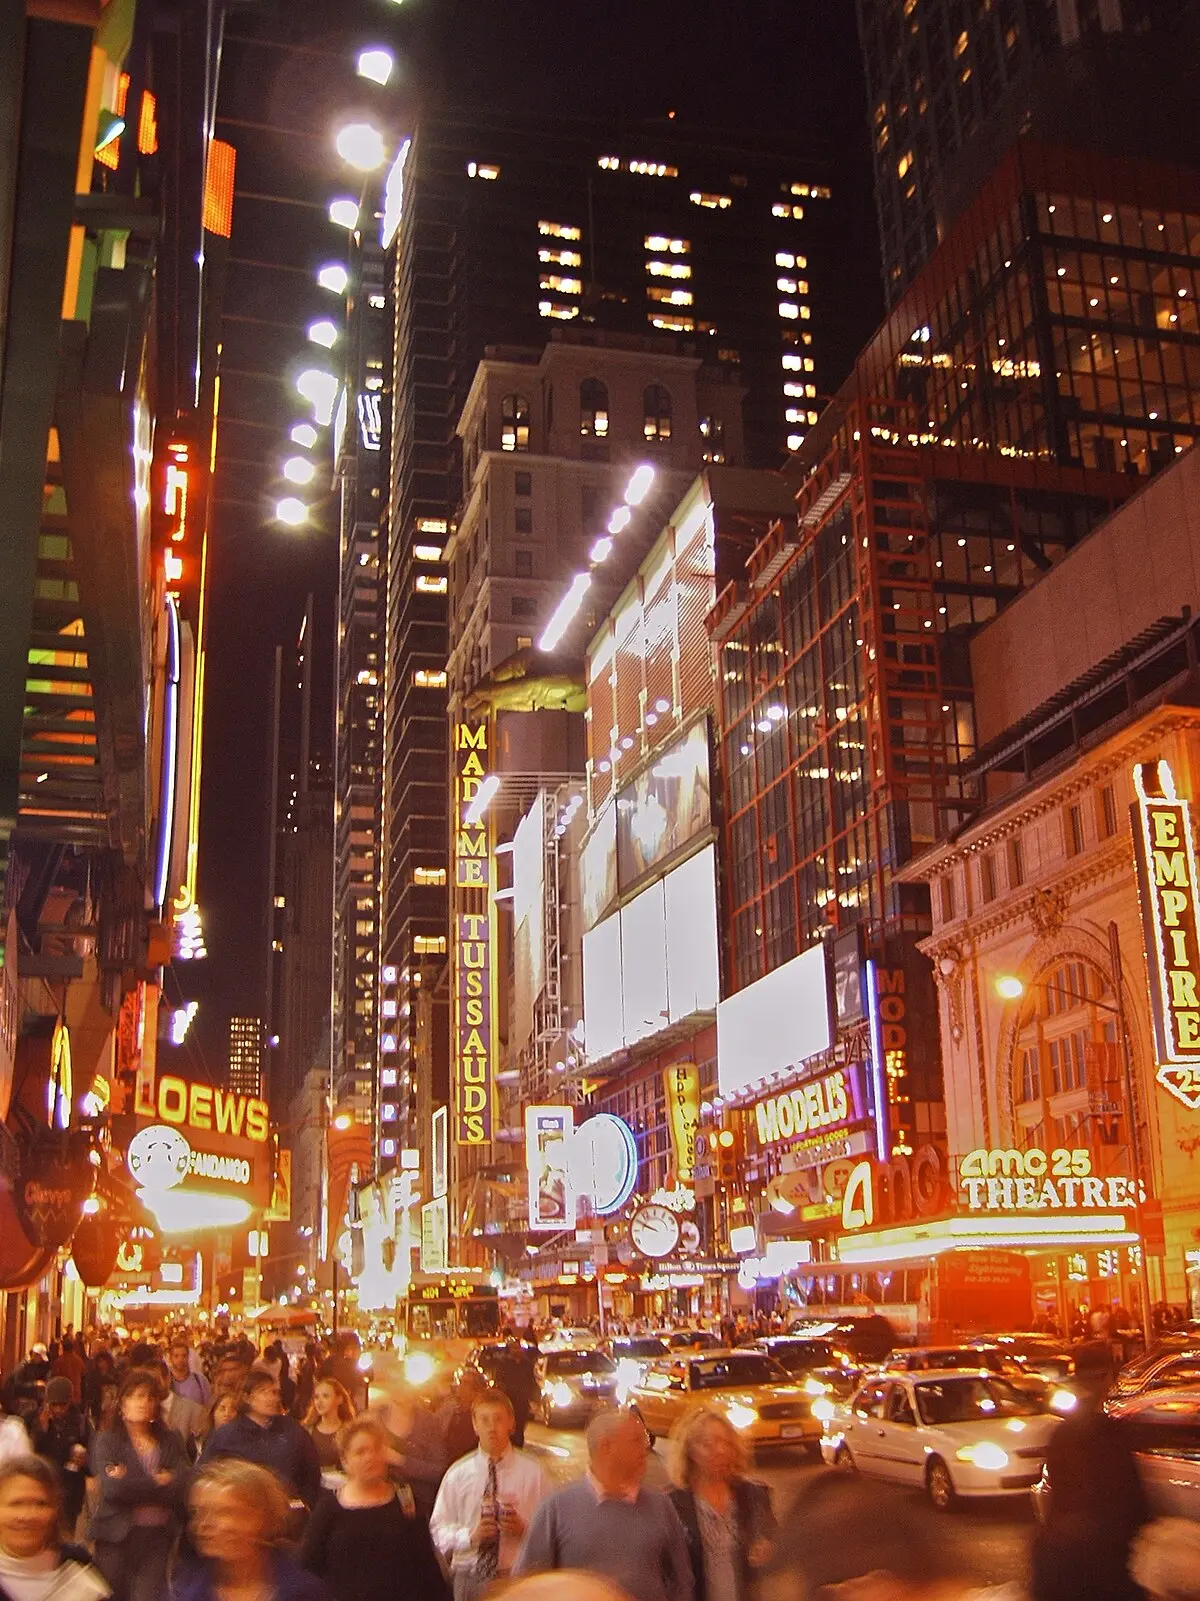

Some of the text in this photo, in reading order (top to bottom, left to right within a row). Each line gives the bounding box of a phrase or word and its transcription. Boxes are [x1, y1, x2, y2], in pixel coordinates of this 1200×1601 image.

[1151, 811, 1200, 1049] EMPIRE
[134, 1071, 269, 1143] LOEWS
[1051, 1149, 1092, 1176] 25
[960, 1177, 1146, 1208] THEATRES
